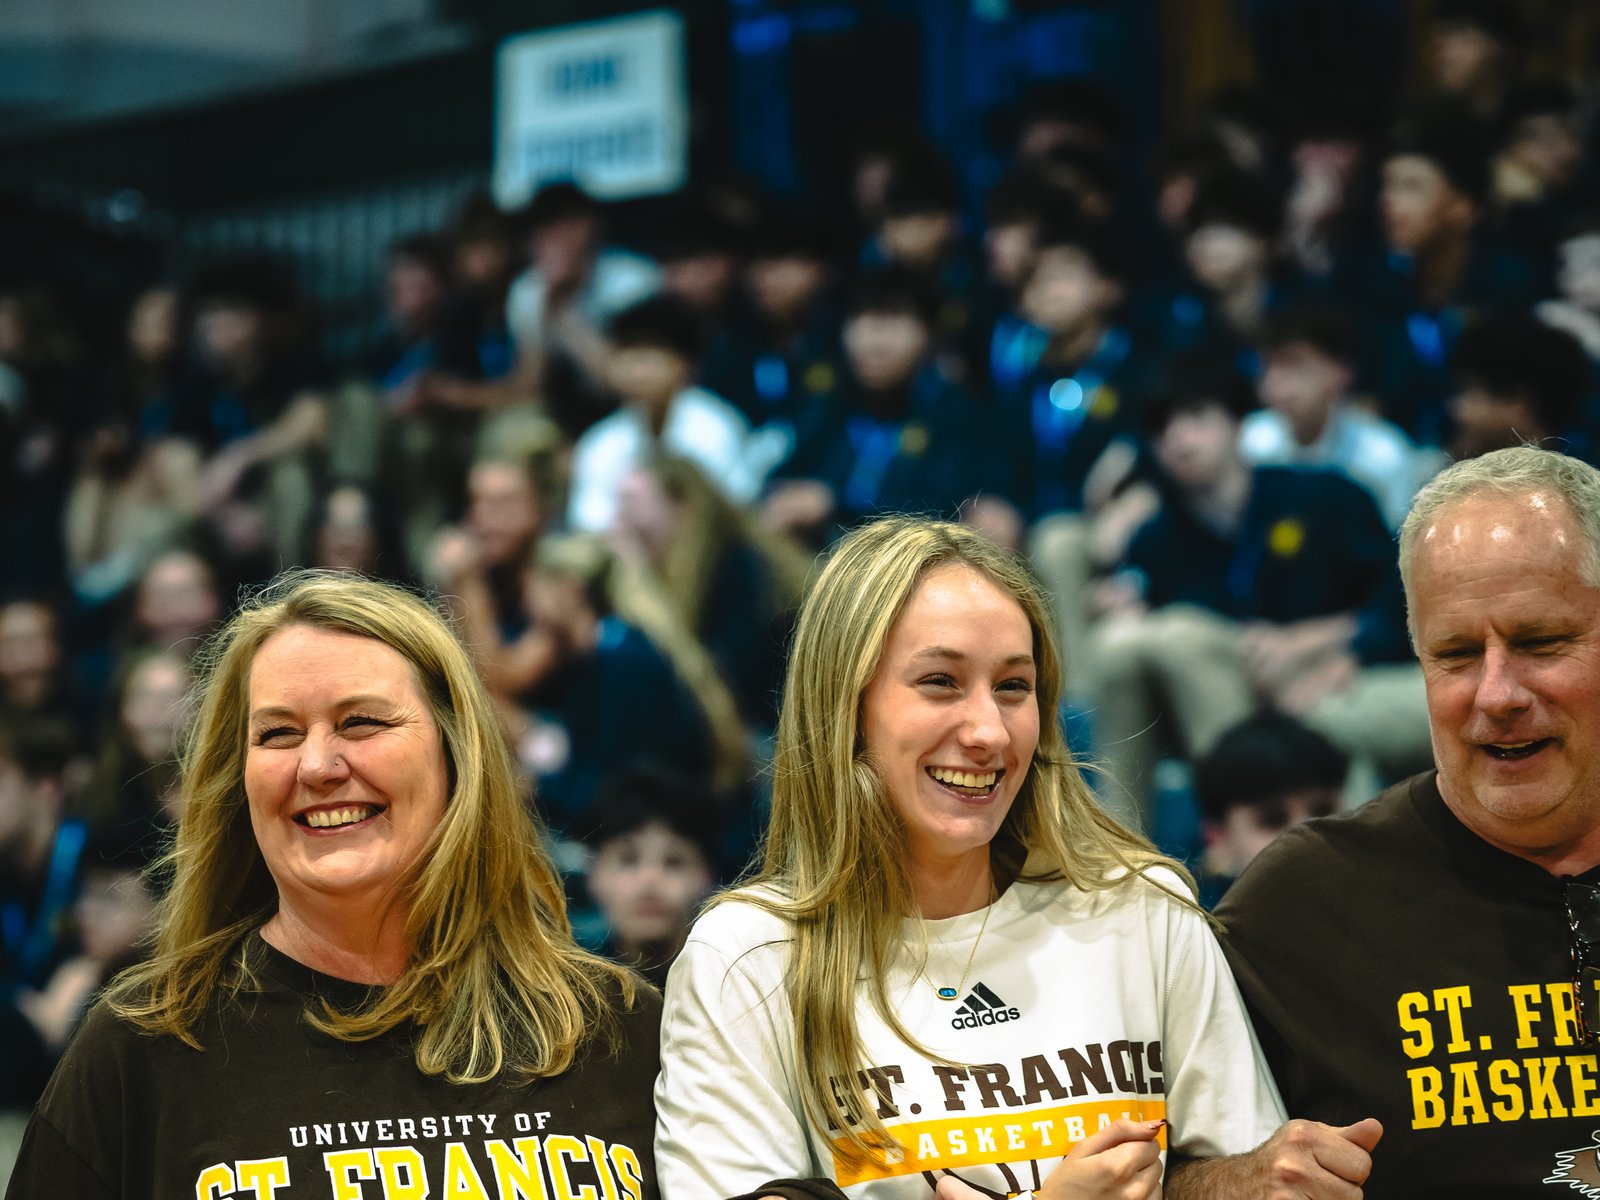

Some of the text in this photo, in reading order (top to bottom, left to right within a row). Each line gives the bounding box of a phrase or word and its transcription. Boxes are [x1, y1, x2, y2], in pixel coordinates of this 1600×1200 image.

[951, 1005, 1021, 1030] adidas
[1397, 985, 1492, 1059] ST.
[932, 1040, 1165, 1112] FRANCIS
[1406, 1055, 1600, 1130] BASKE
[289, 1111, 551, 1147] UNIVERSITY OF
